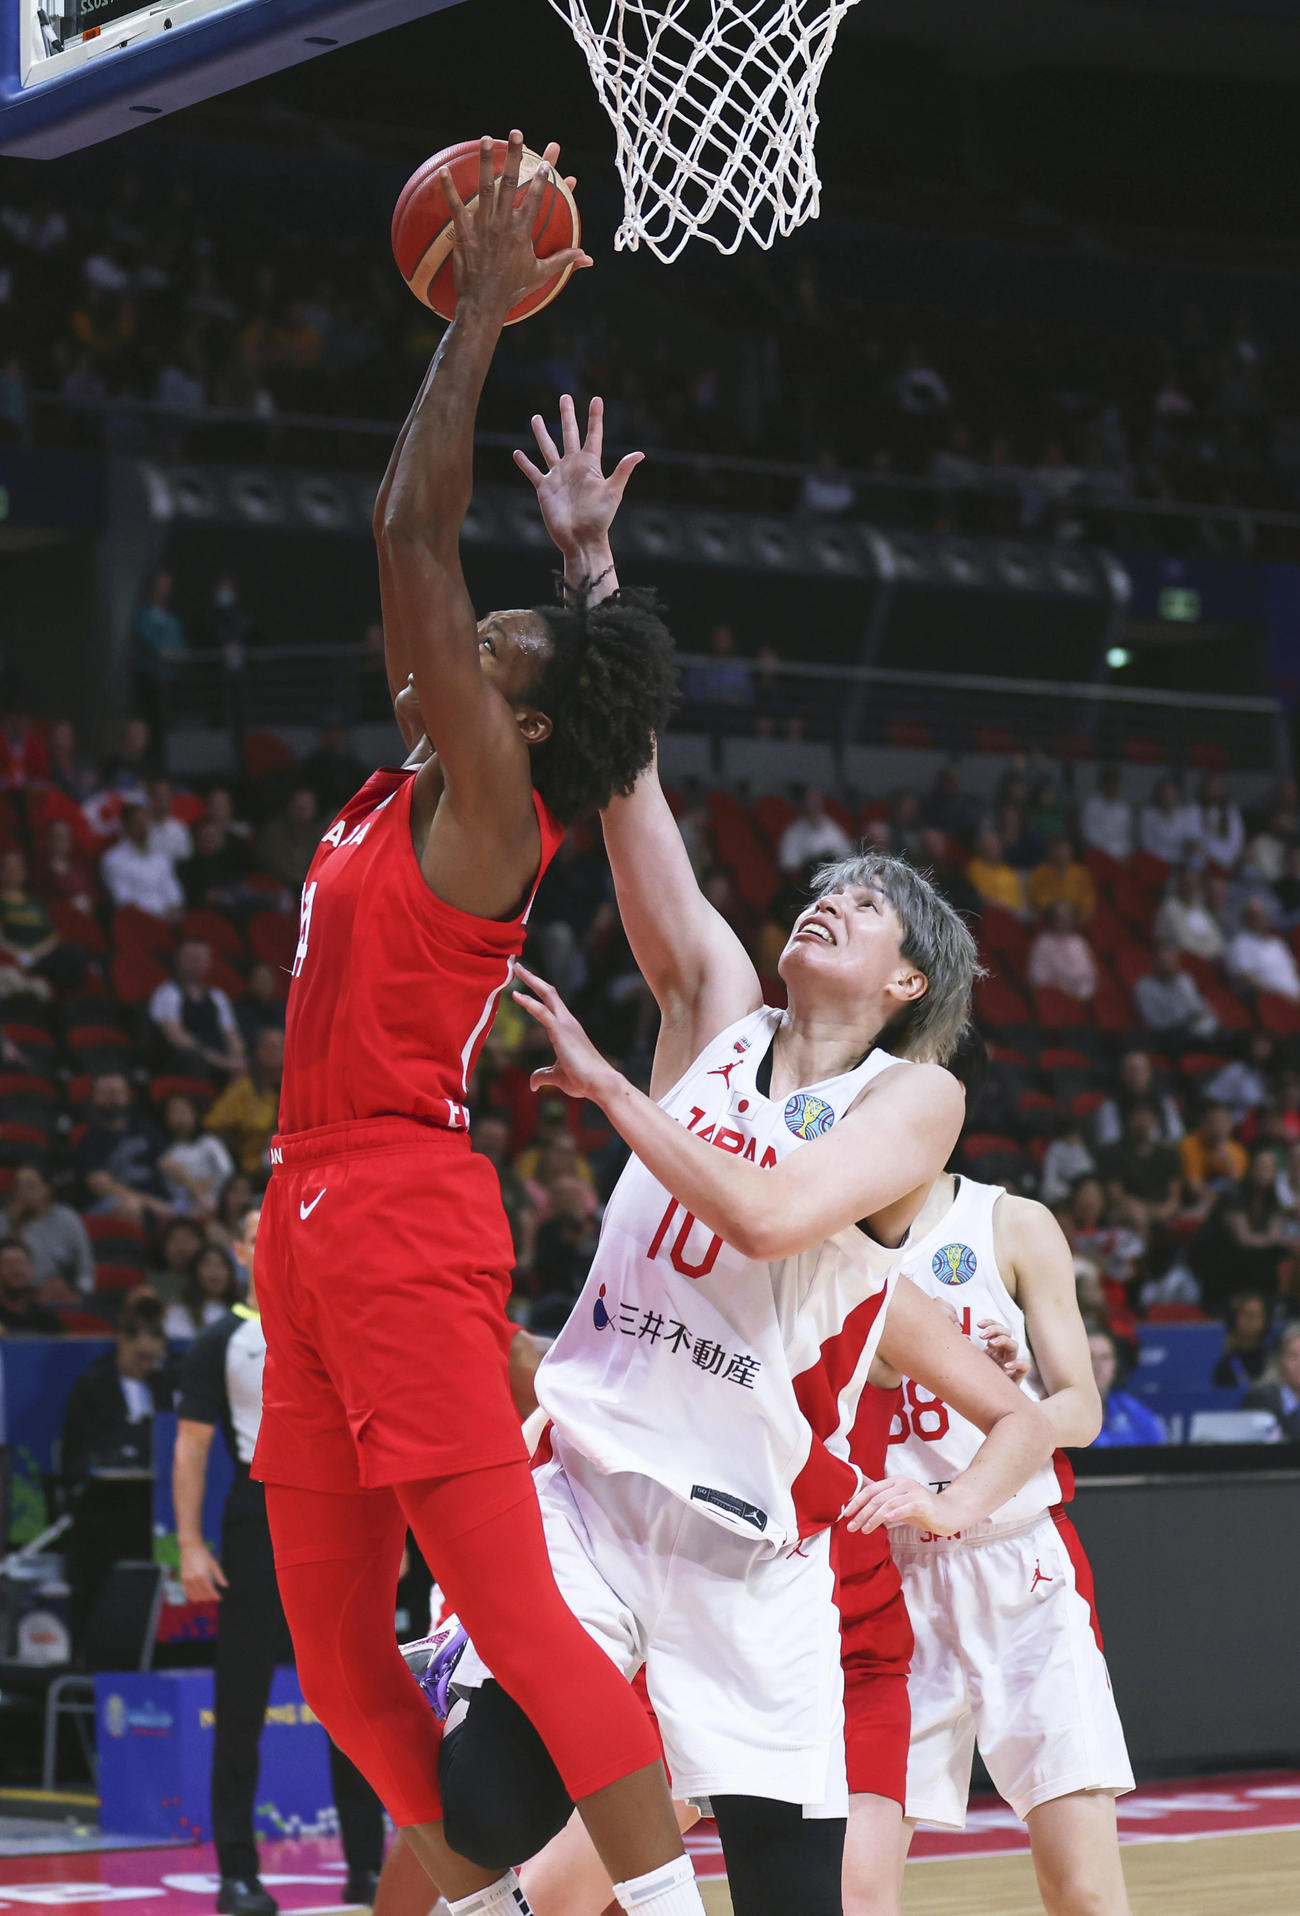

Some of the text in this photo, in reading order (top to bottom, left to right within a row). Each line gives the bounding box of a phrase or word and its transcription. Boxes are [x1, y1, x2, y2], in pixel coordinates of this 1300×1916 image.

[646, 1196, 724, 1279] 10
[619, 1302, 761, 1390] 三井不動産
